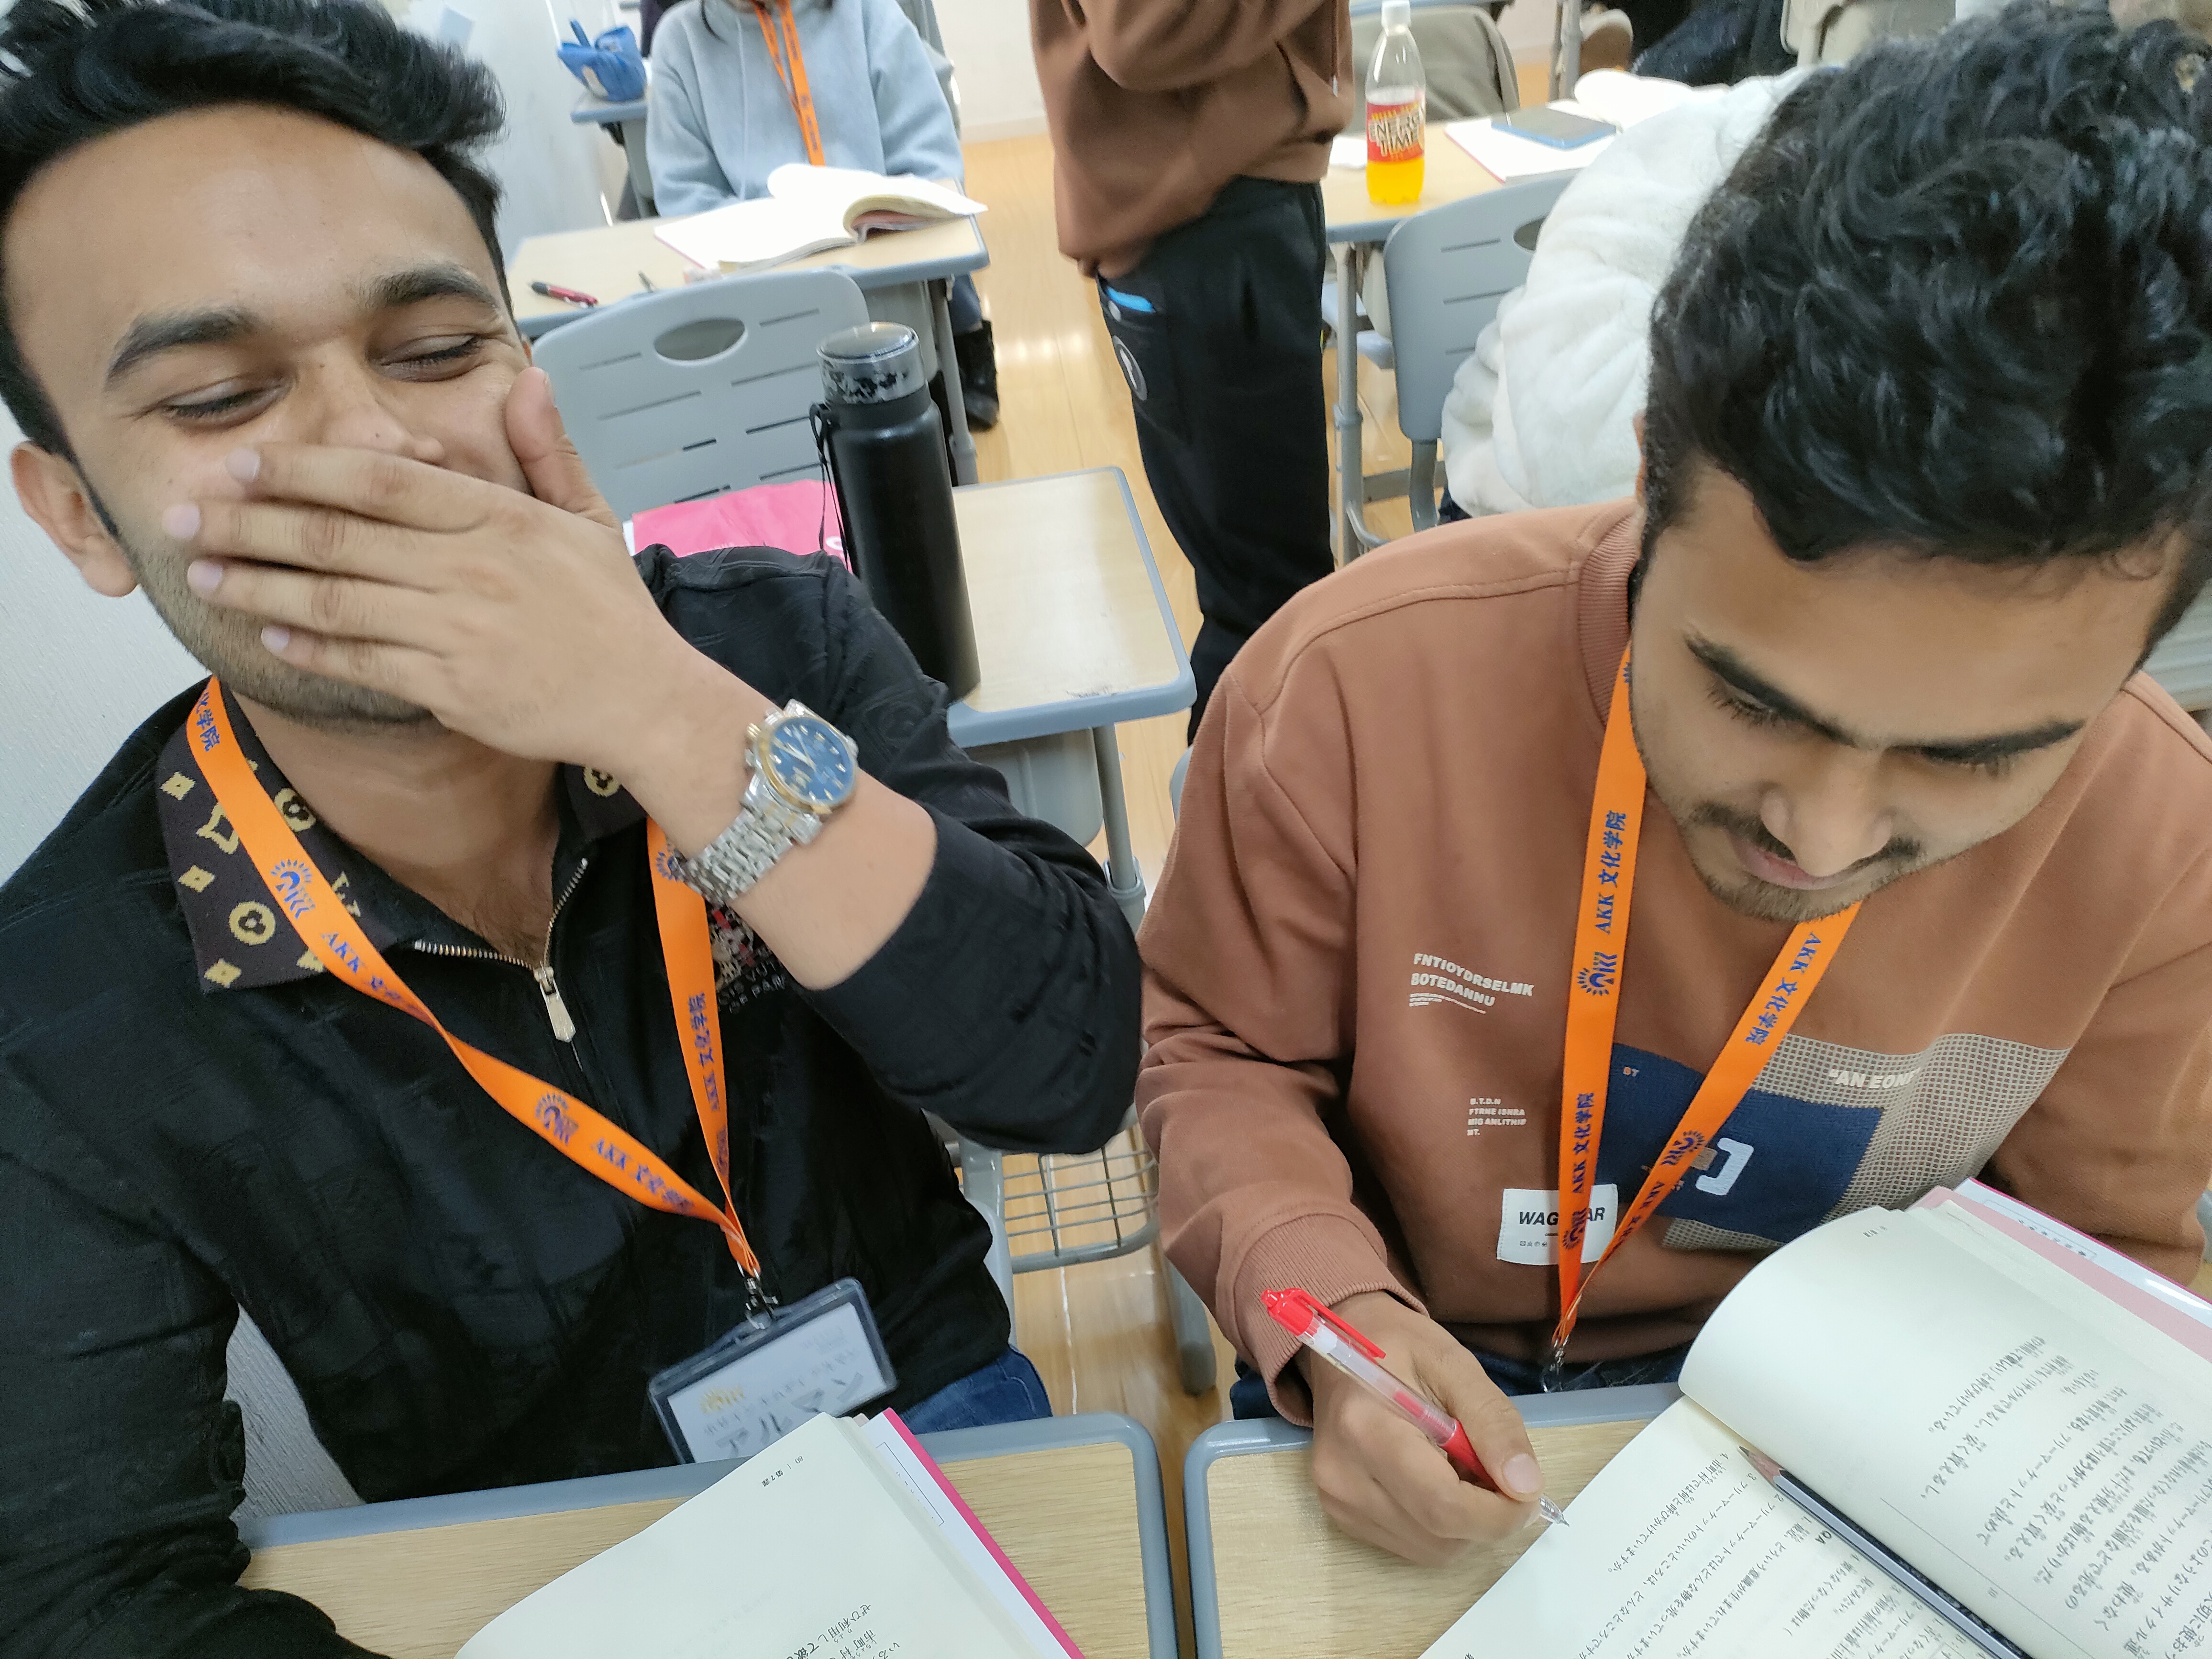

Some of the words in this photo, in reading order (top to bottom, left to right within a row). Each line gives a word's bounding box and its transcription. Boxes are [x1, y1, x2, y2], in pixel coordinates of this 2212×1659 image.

[1598, 810, 1626, 888] 文化学院
[1594, 893, 1615, 935] AKK
[321, 932, 365, 974] AKK
[1789, 931, 1822, 974] AKK
[1410, 973, 1496, 1006] BOTEDANNU
[1413, 953, 1535, 996] FNTIOYDRSELMK
[1745, 977, 1798, 1046] 文化学院
[1814, 1525, 1832, 1545] QA
